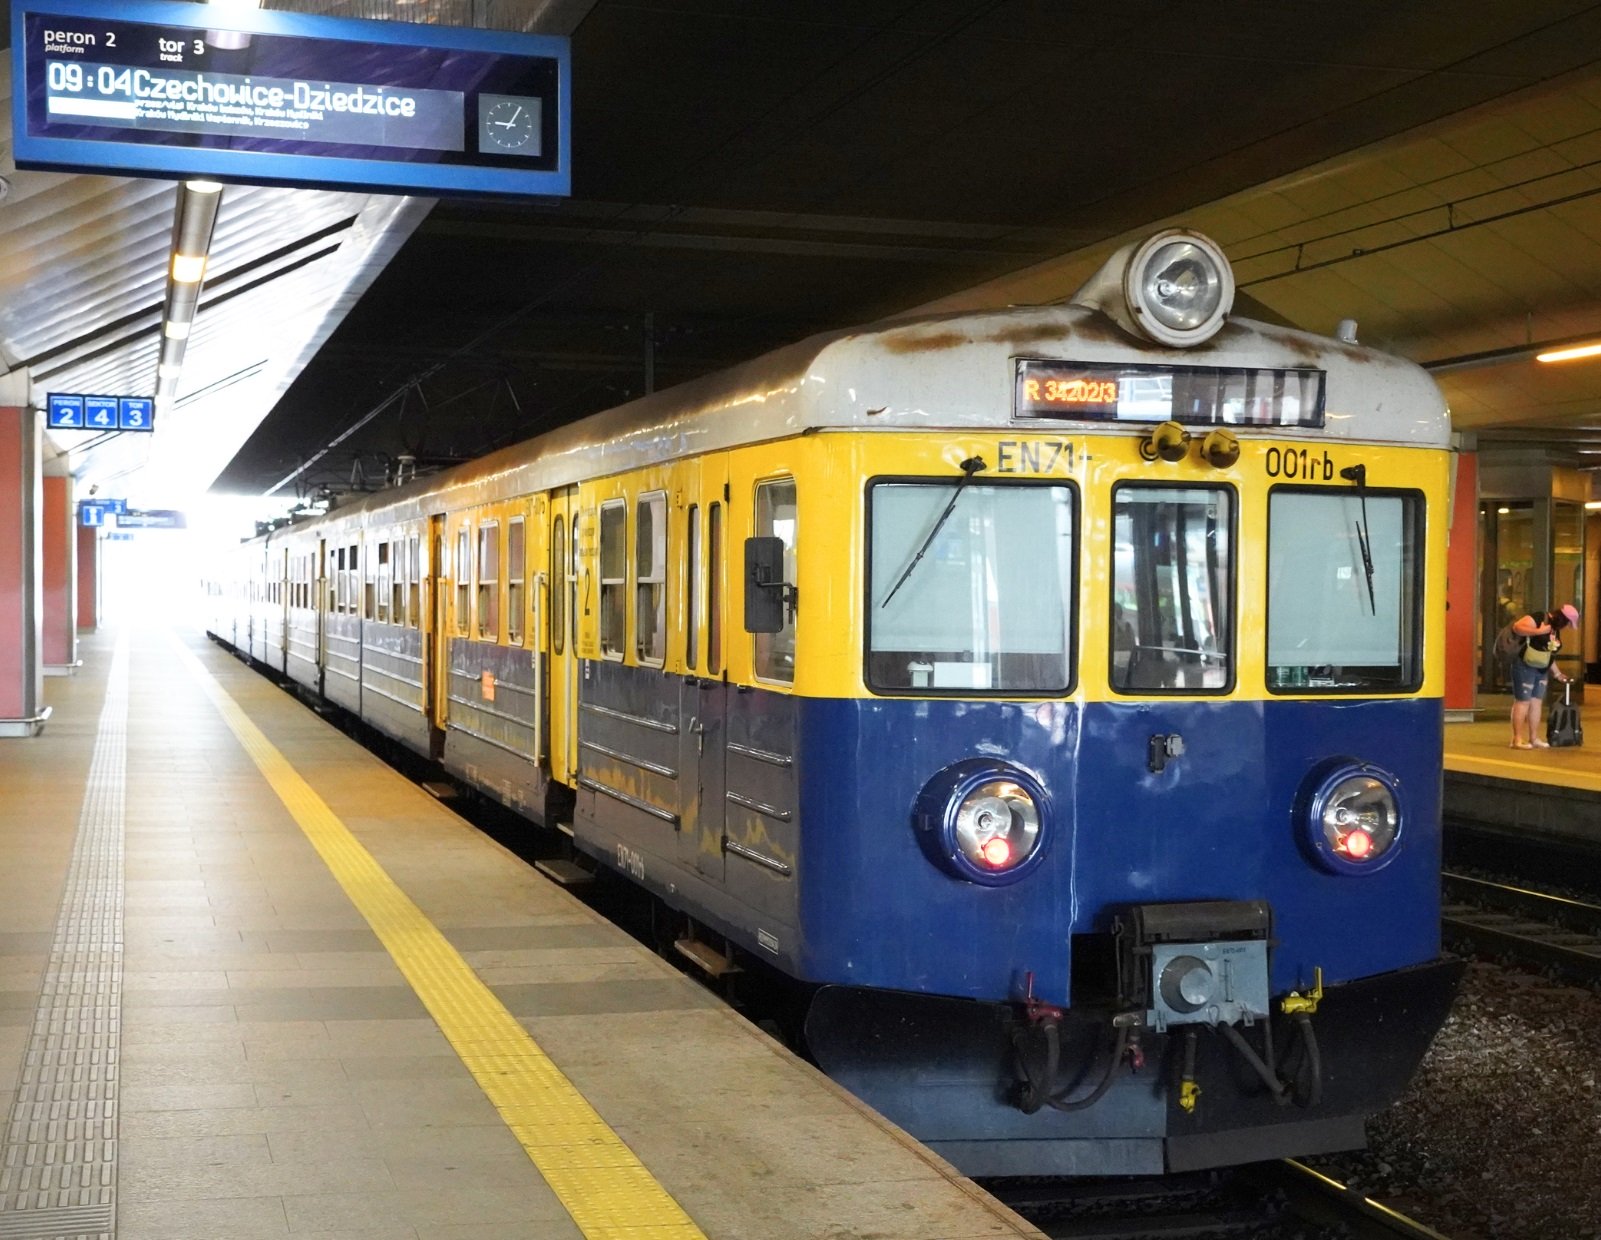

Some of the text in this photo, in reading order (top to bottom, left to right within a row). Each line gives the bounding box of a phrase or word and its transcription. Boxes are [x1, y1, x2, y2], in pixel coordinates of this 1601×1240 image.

[44, 30, 116, 47] peron 2
[158, 37, 205, 55] tor 3
[44, 43, 85, 54] platform
[160, 53, 183, 63] track
[48, 62, 415, 117] 09:04 Czechowice-Dziedzice
[1024, 379, 1116, 403] R 34202/3
[59, 408, 74, 424] 2
[94, 409, 110, 425] 4
[129, 410, 143, 426] 3
[1266, 447, 1333, 480] 001rb
